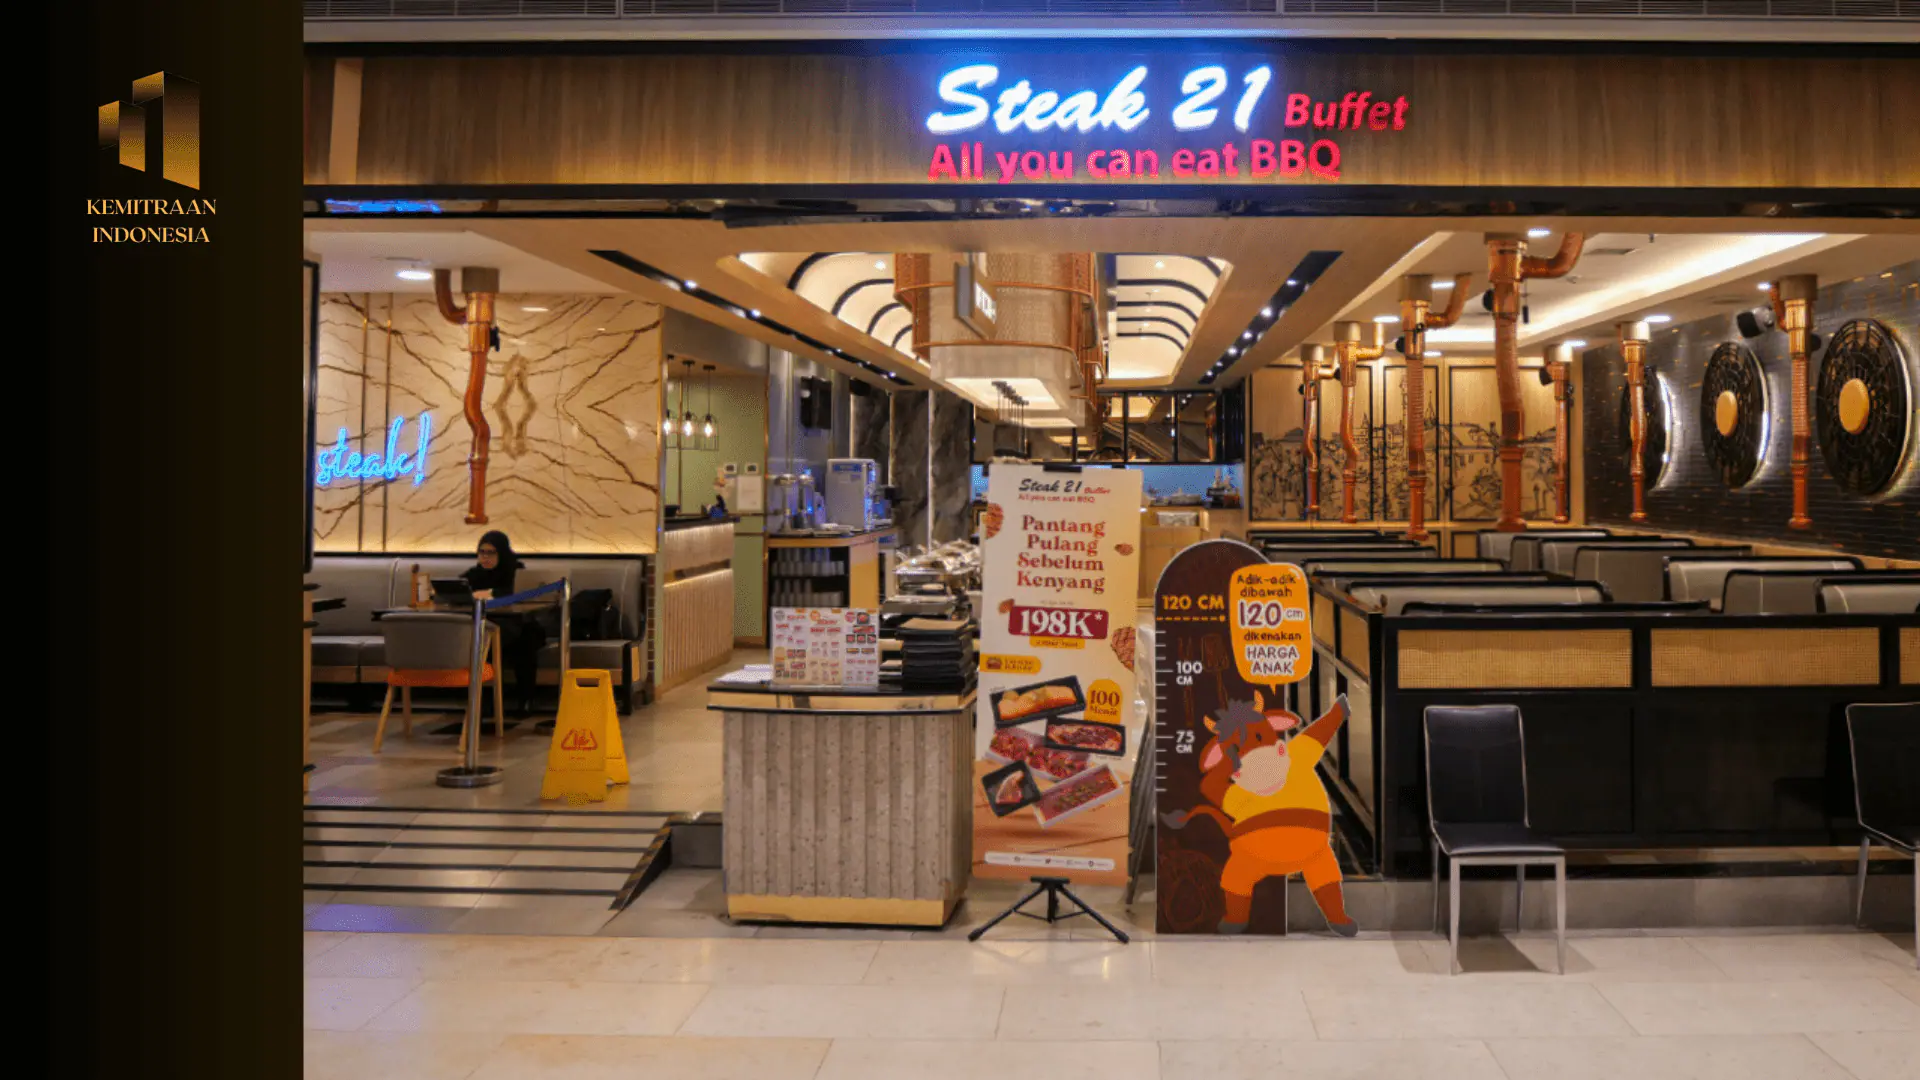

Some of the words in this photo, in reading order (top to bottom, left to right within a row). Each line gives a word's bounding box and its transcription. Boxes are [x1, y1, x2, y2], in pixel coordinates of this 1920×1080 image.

[926, 64, 1150, 133] Steak
[1172, 64, 1272, 133] 21
[1284, 90, 1409, 131] Buffet
[927, 142, 983, 181] All
[996, 149, 1074, 184] you
[1087, 147, 1159, 179] can
[1171, 143, 1240, 179] eat
[1250, 139, 1342, 181] BBQ
[316, 411, 432, 488] steak!
[1018, 478, 1060, 493] Steak
[1063, 479, 1082, 493] 21
[1022, 514, 1106, 538] Pantang
[1027, 533, 1099, 556] Pulang
[1016, 552, 1104, 571] Sebelum
[1016, 570, 1105, 594] Kenyang
[1236, 574, 1297, 585] Adik-adik
[1240, 586, 1293, 598] dibawah
[1161, 594, 1191, 610] 120
[1197, 595, 1225, 610] CM
[1237, 601, 1283, 627] 120
[1285, 608, 1304, 620] cm
[1243, 631, 1302, 642] dikenakan
[1246, 645, 1299, 660] HARGA
[1176, 660, 1202, 674] 100
[1251, 660, 1294, 675] ANAK
[1176, 675, 1193, 686] CM
[1090, 689, 1120, 707] 100
[1176, 730, 1195, 744] 75
[1176, 744, 1193, 755] CM
